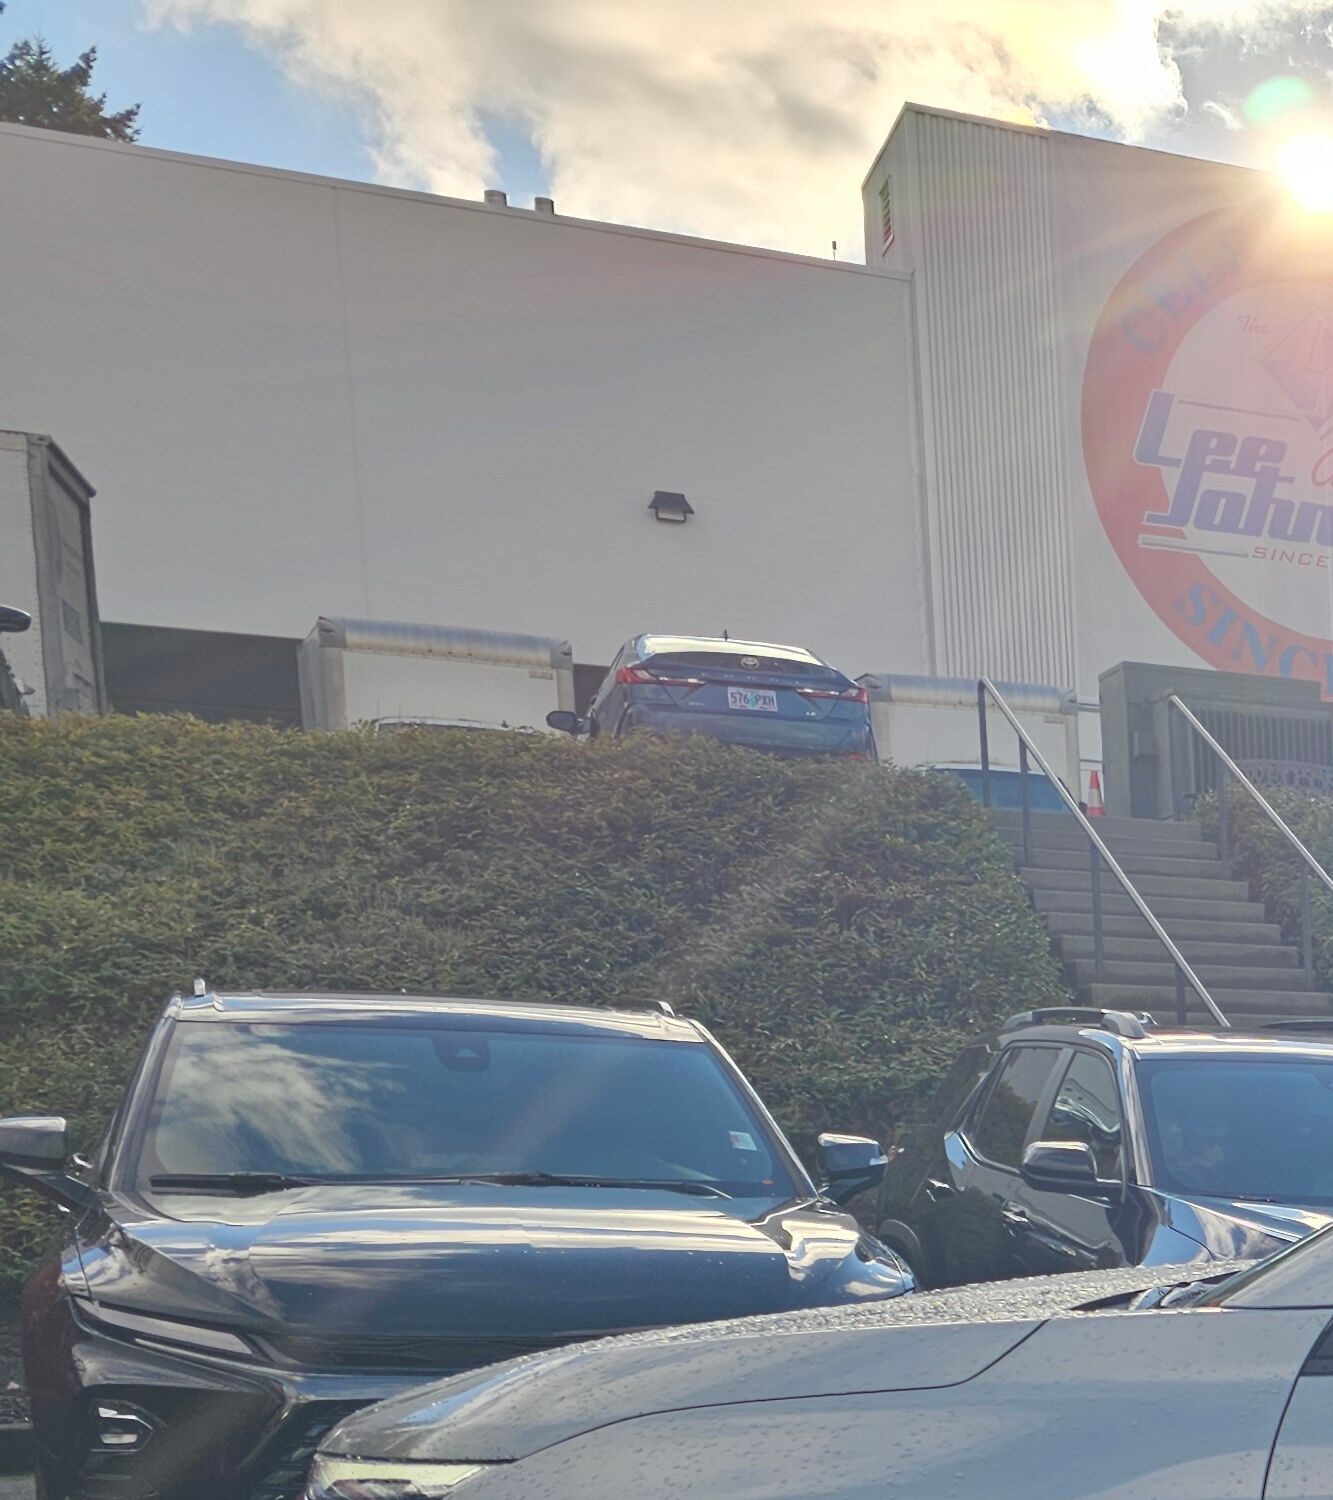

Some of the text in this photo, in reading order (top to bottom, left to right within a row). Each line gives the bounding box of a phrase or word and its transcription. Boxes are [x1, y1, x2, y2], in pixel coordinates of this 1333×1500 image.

[1238, 313, 1269, 336] The
[1134, 390, 1287, 478] Lee
[1251, 546, 1329, 568] SINCE
